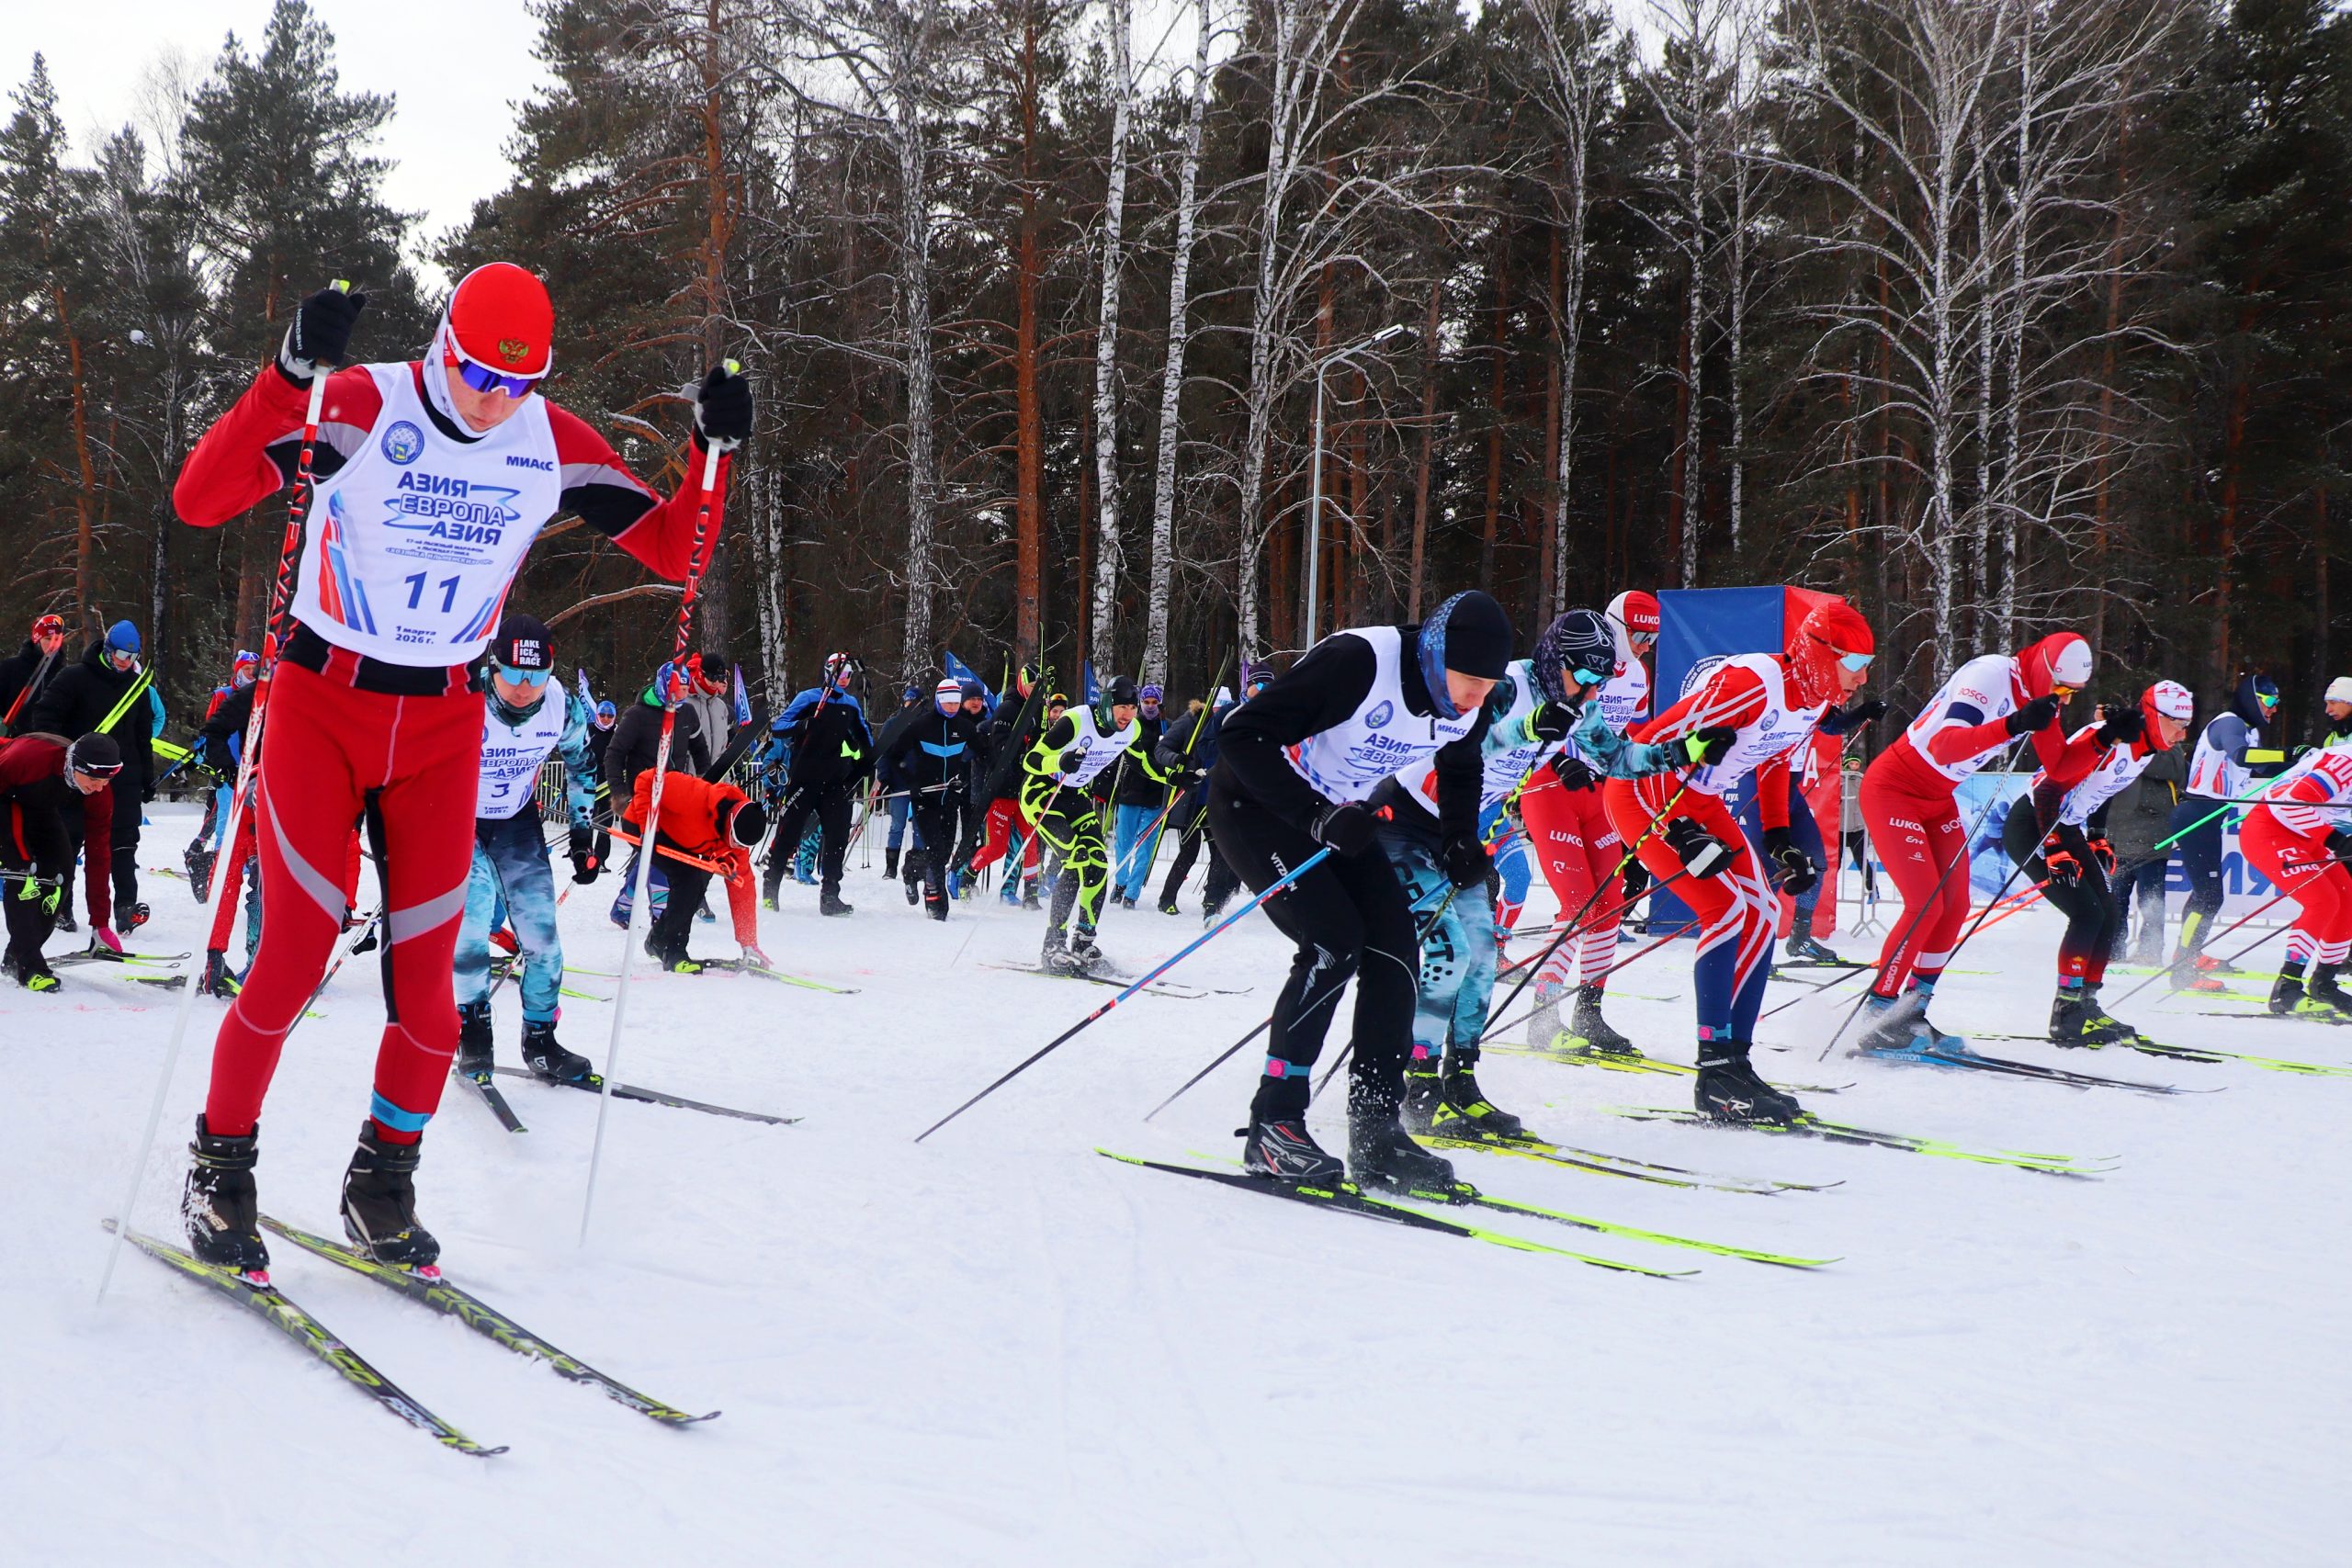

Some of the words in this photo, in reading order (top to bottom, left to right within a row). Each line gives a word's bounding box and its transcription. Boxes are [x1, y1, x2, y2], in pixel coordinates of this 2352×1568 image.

[295, 308, 303, 350] NORDSKI
[506, 456, 553, 471] МИАСС
[397, 470, 469, 498] АЗИЯ
[400, 493, 505, 527] ЕВРОПА
[428, 521, 502, 546] АЗИЯ
[404, 570, 461, 613] 11
[402, 627, 436, 636] марта
[395, 634, 424, 644] 2026
[519, 639, 540, 649] LAKE
[519, 649, 534, 657] ICE
[519, 656, 541, 666] RACE
[1598, 694, 1622, 705] АЗИЯ
[1437, 724, 1467, 736] МИАСС
[1363, 733, 1412, 754] АЗИЯ
[1359, 747, 1421, 766] ЕВРОП
[1075, 773, 1089, 783] 2
[491, 784, 510, 797] 3
[1905, 835, 1925, 845] En+
[1261, 1135, 1308, 1168] SPINE
[1296, 1185, 1335, 1199] FISCHER
